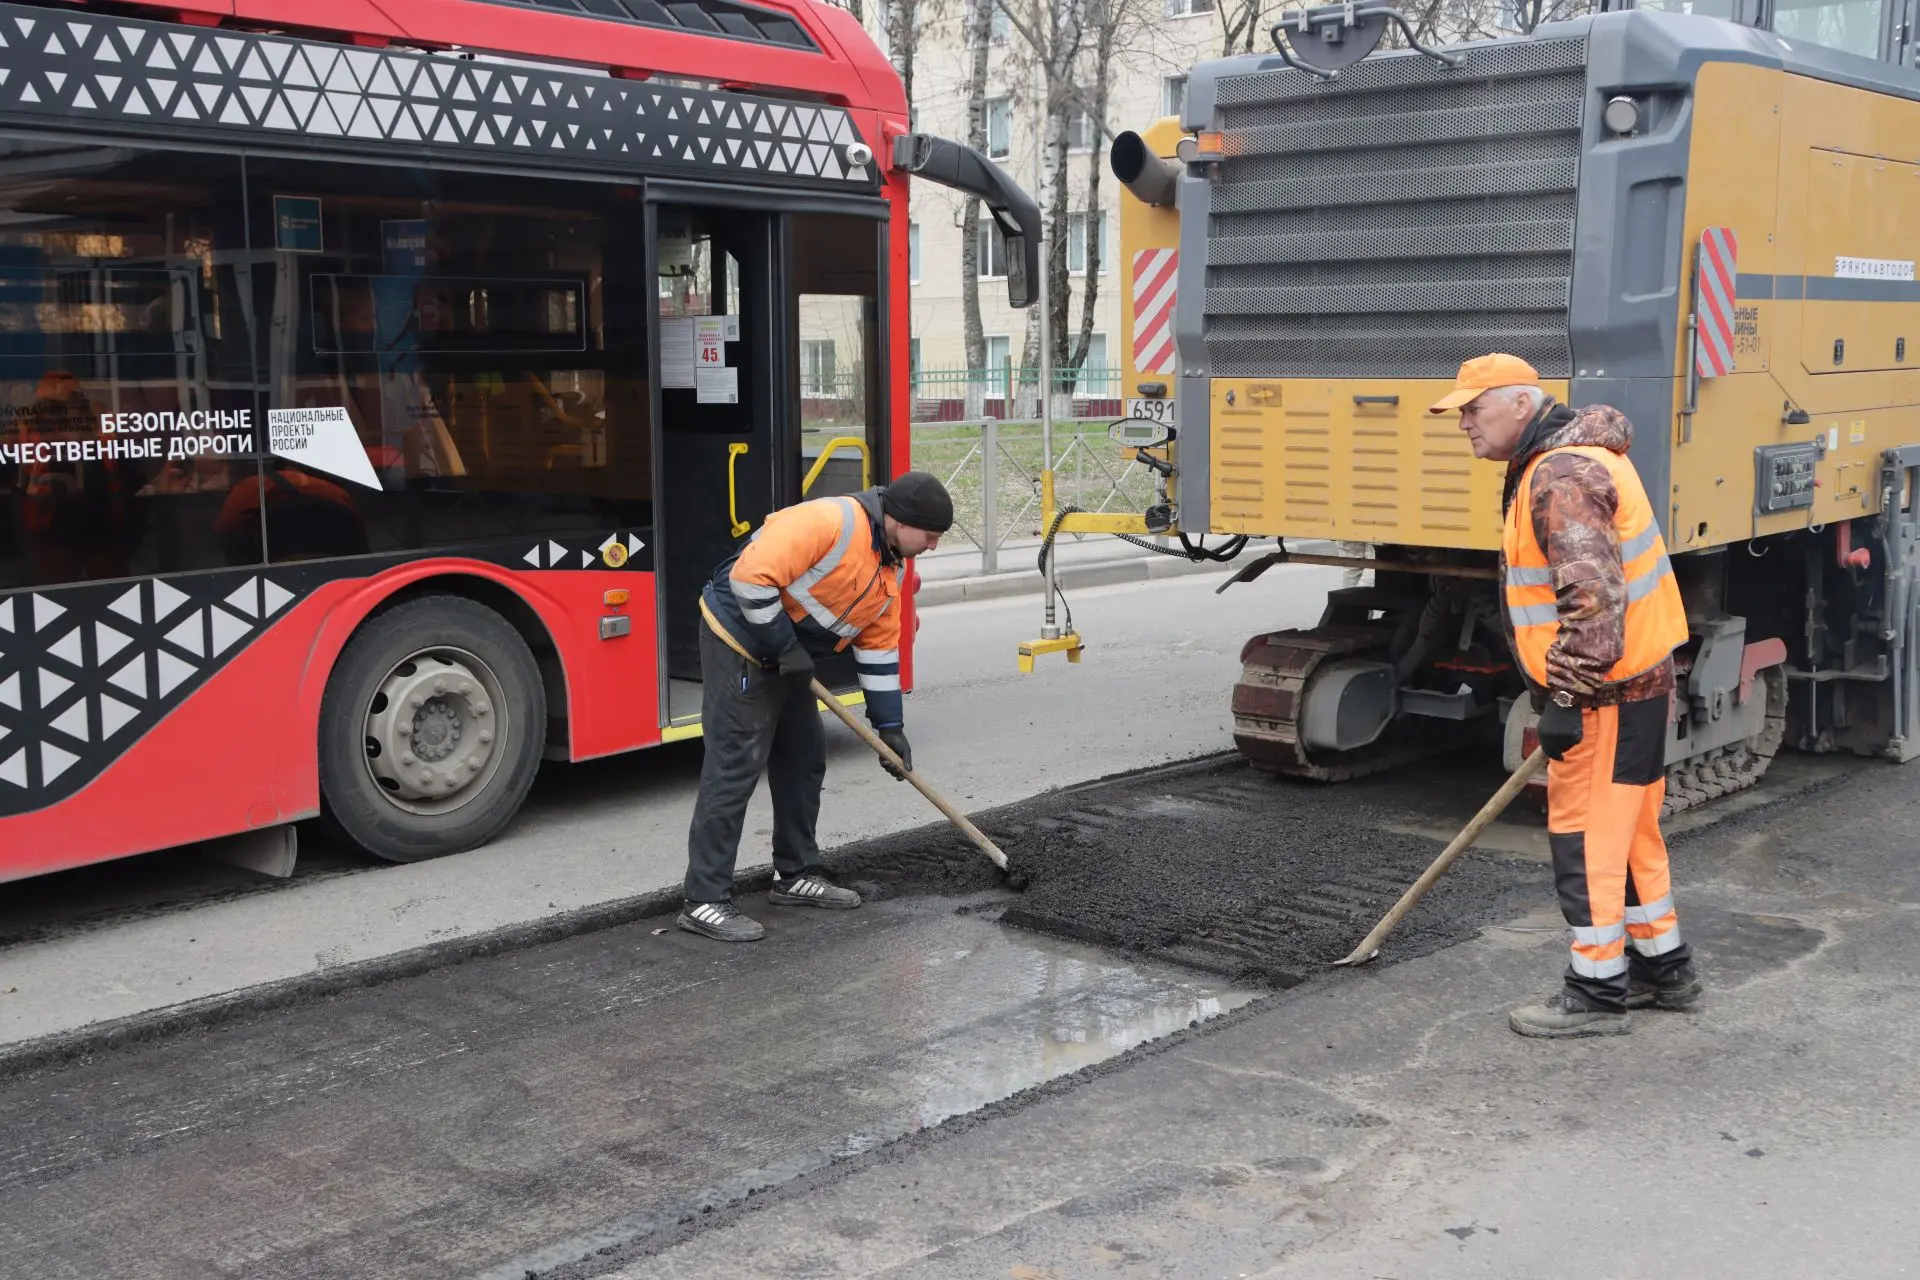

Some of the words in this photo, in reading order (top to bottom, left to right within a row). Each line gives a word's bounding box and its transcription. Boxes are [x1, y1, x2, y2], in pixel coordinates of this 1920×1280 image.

[271, 410, 345, 424] НАЦИОНАЛЬНЫЕ
[1133, 400, 1175, 421] 6591
[100, 409, 252, 434] БЕЗОПАСНЫЕ
[272, 424, 314, 437] ПРОЕКТЫ
[167, 434, 253, 461] ДОРОГИ
[273, 438, 308, 450] РОССИИ
